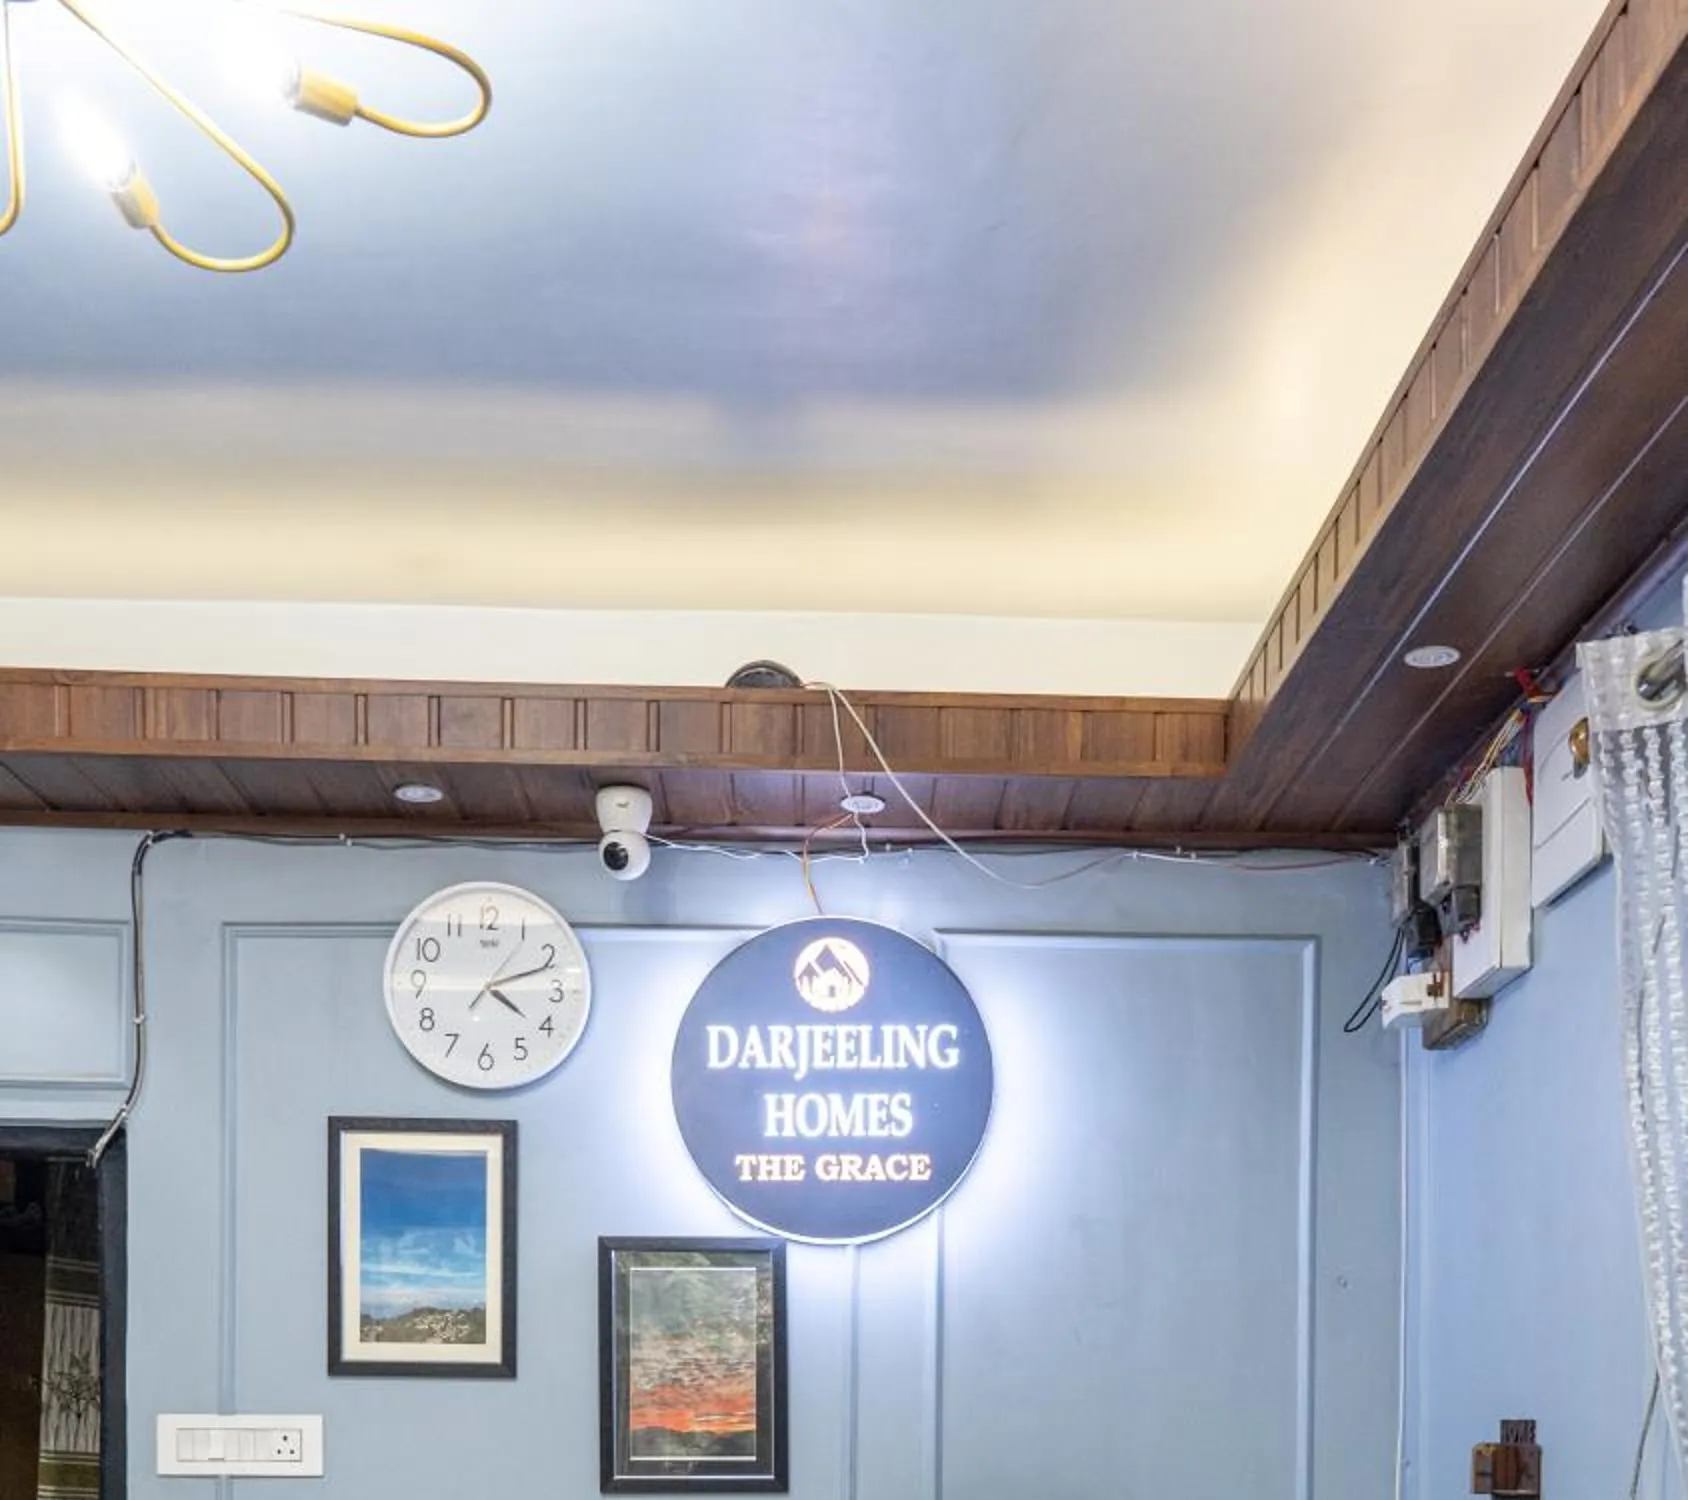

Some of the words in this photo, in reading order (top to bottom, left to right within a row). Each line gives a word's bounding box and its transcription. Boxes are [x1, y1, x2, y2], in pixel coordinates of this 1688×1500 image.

[446, 913, 462, 937] 11
[479, 905, 499, 931] 12
[520, 917, 526, 941] 1
[416, 937, 441, 962] 10
[540, 943, 556, 969] 2
[410, 969, 427, 999] 9
[548, 979, 564, 1003] 3
[419, 1007, 435, 1031] 8
[538, 1015, 554, 1038] 4
[444, 1033, 460, 1058] 7
[477, 1043, 495, 1071] 6
[514, 1037, 528, 1061] 5
[705, 1024, 960, 1080] DARJEELING
[762, 1093, 913, 1138] HOMES
[735, 1154, 805, 1181] THE
[815, 1154, 932, 1182] GRACE
